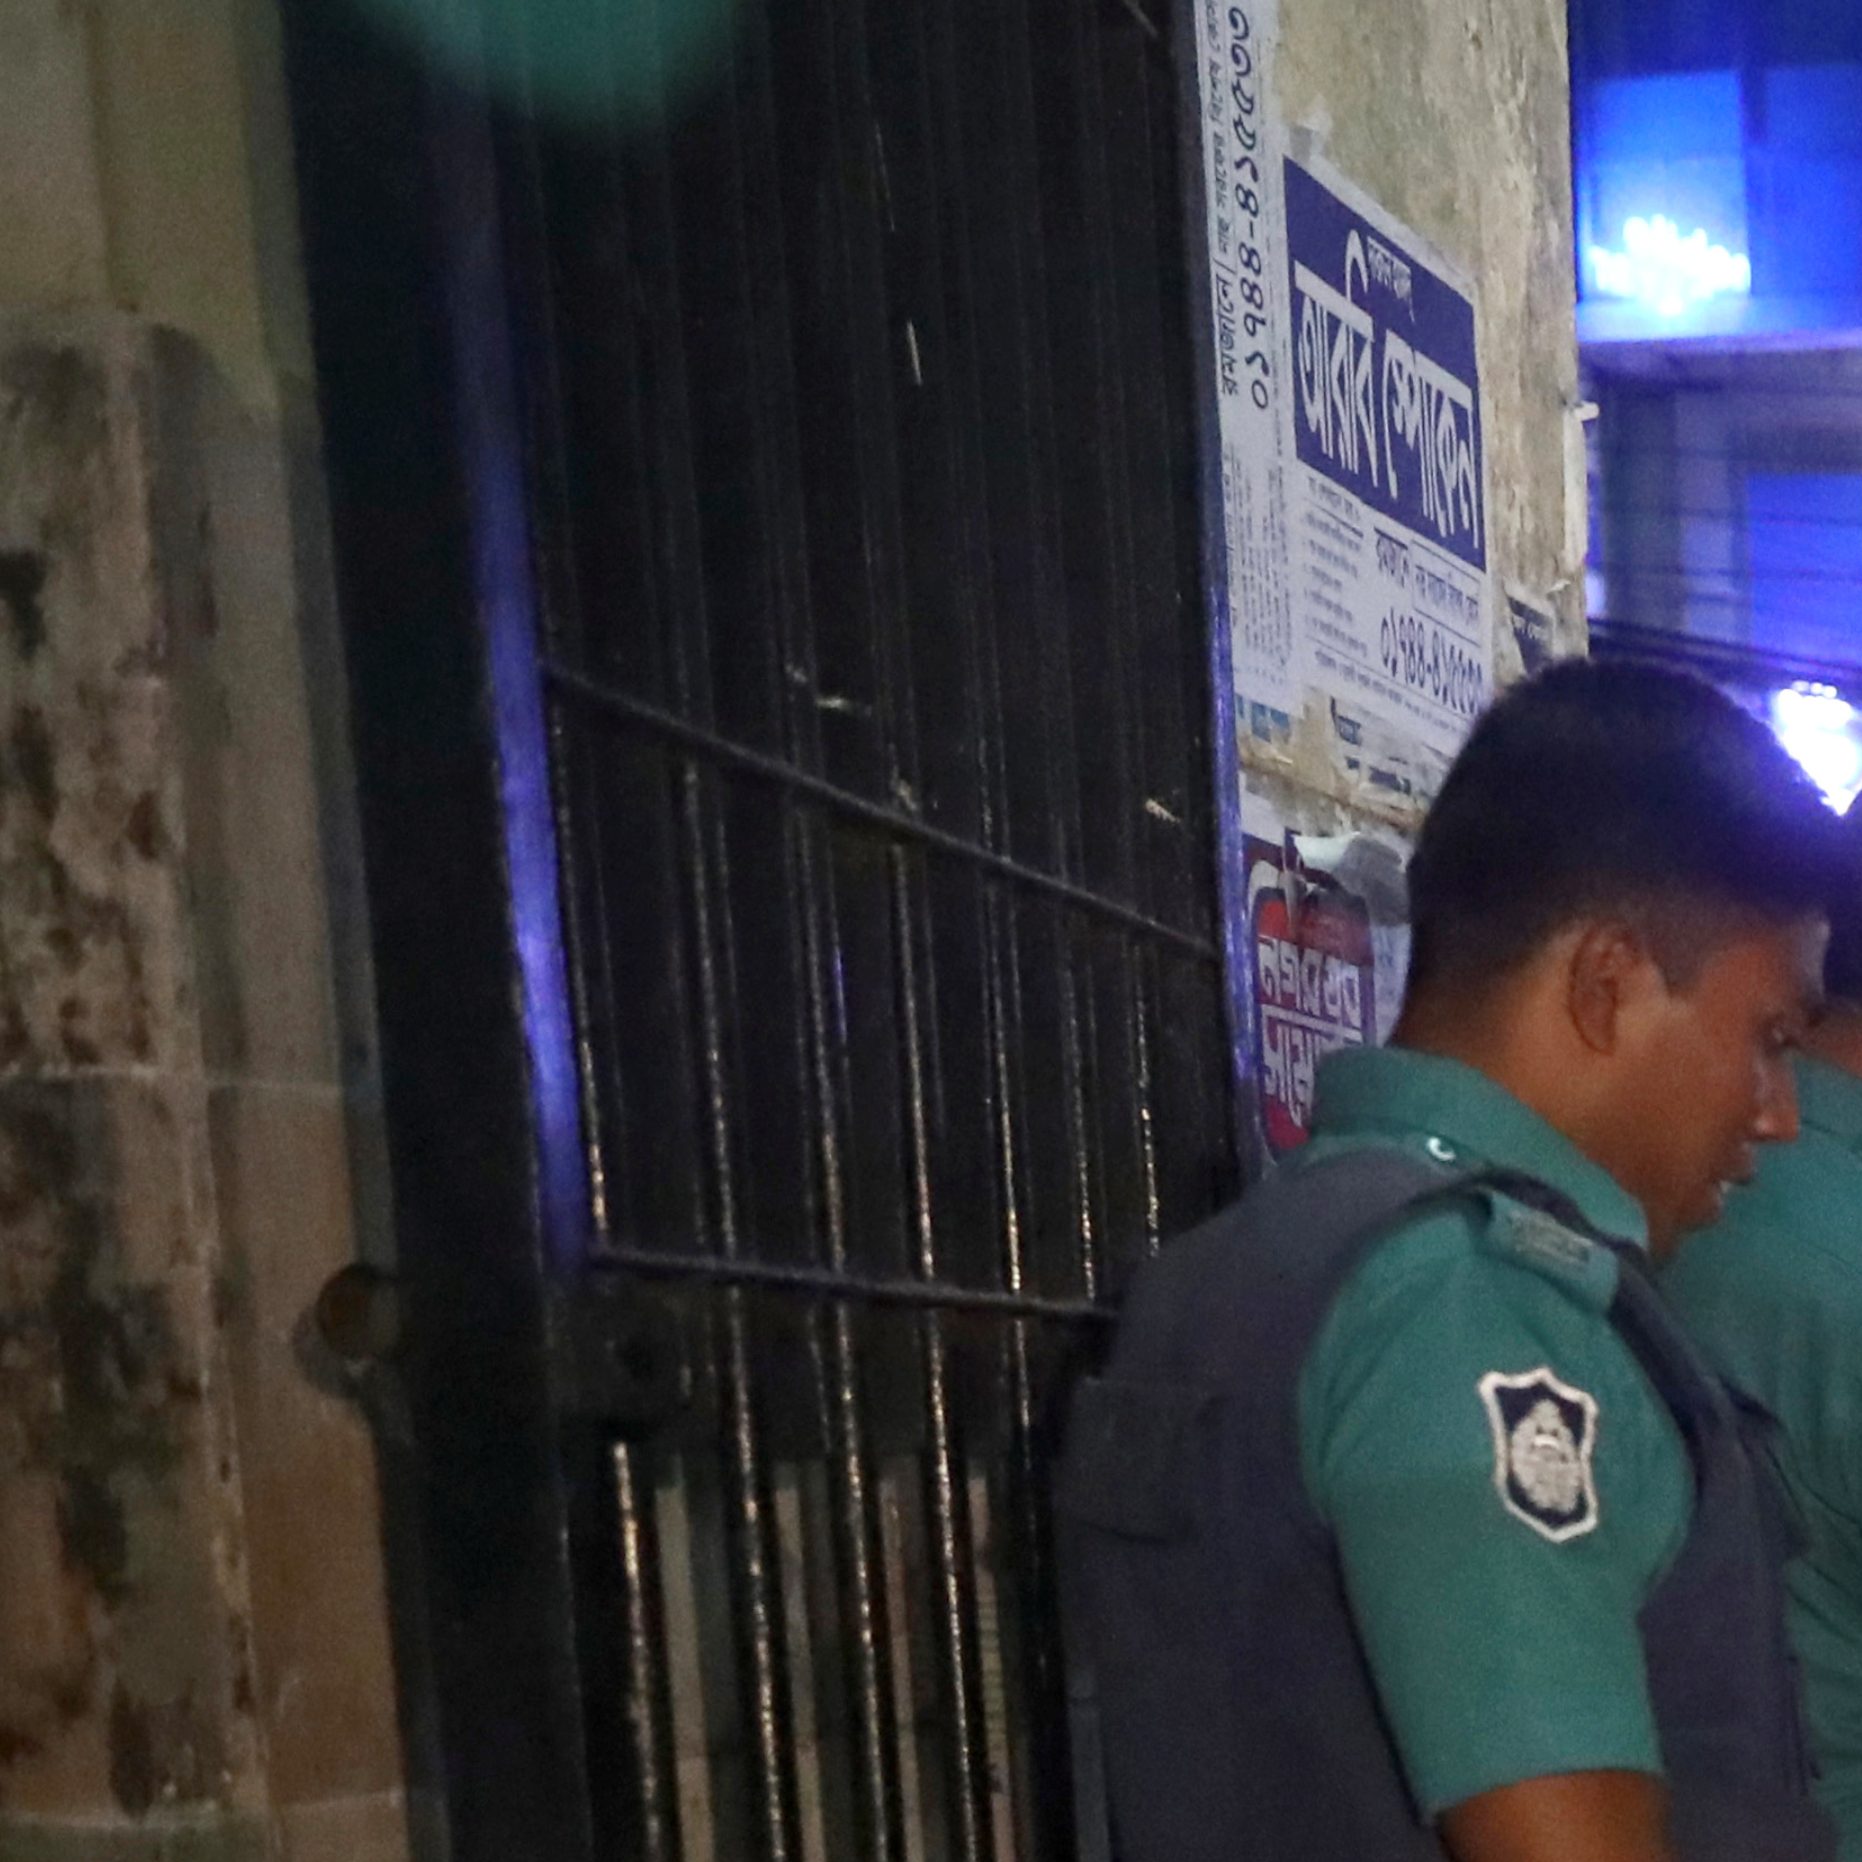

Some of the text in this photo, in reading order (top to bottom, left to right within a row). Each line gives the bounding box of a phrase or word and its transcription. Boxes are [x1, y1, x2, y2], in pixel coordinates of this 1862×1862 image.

[1227, 7, 1269, 410] ০১৭৪৪-৪১৫৫৩৩
[1293, 229, 1480, 549] আরবি স্পোকেন
